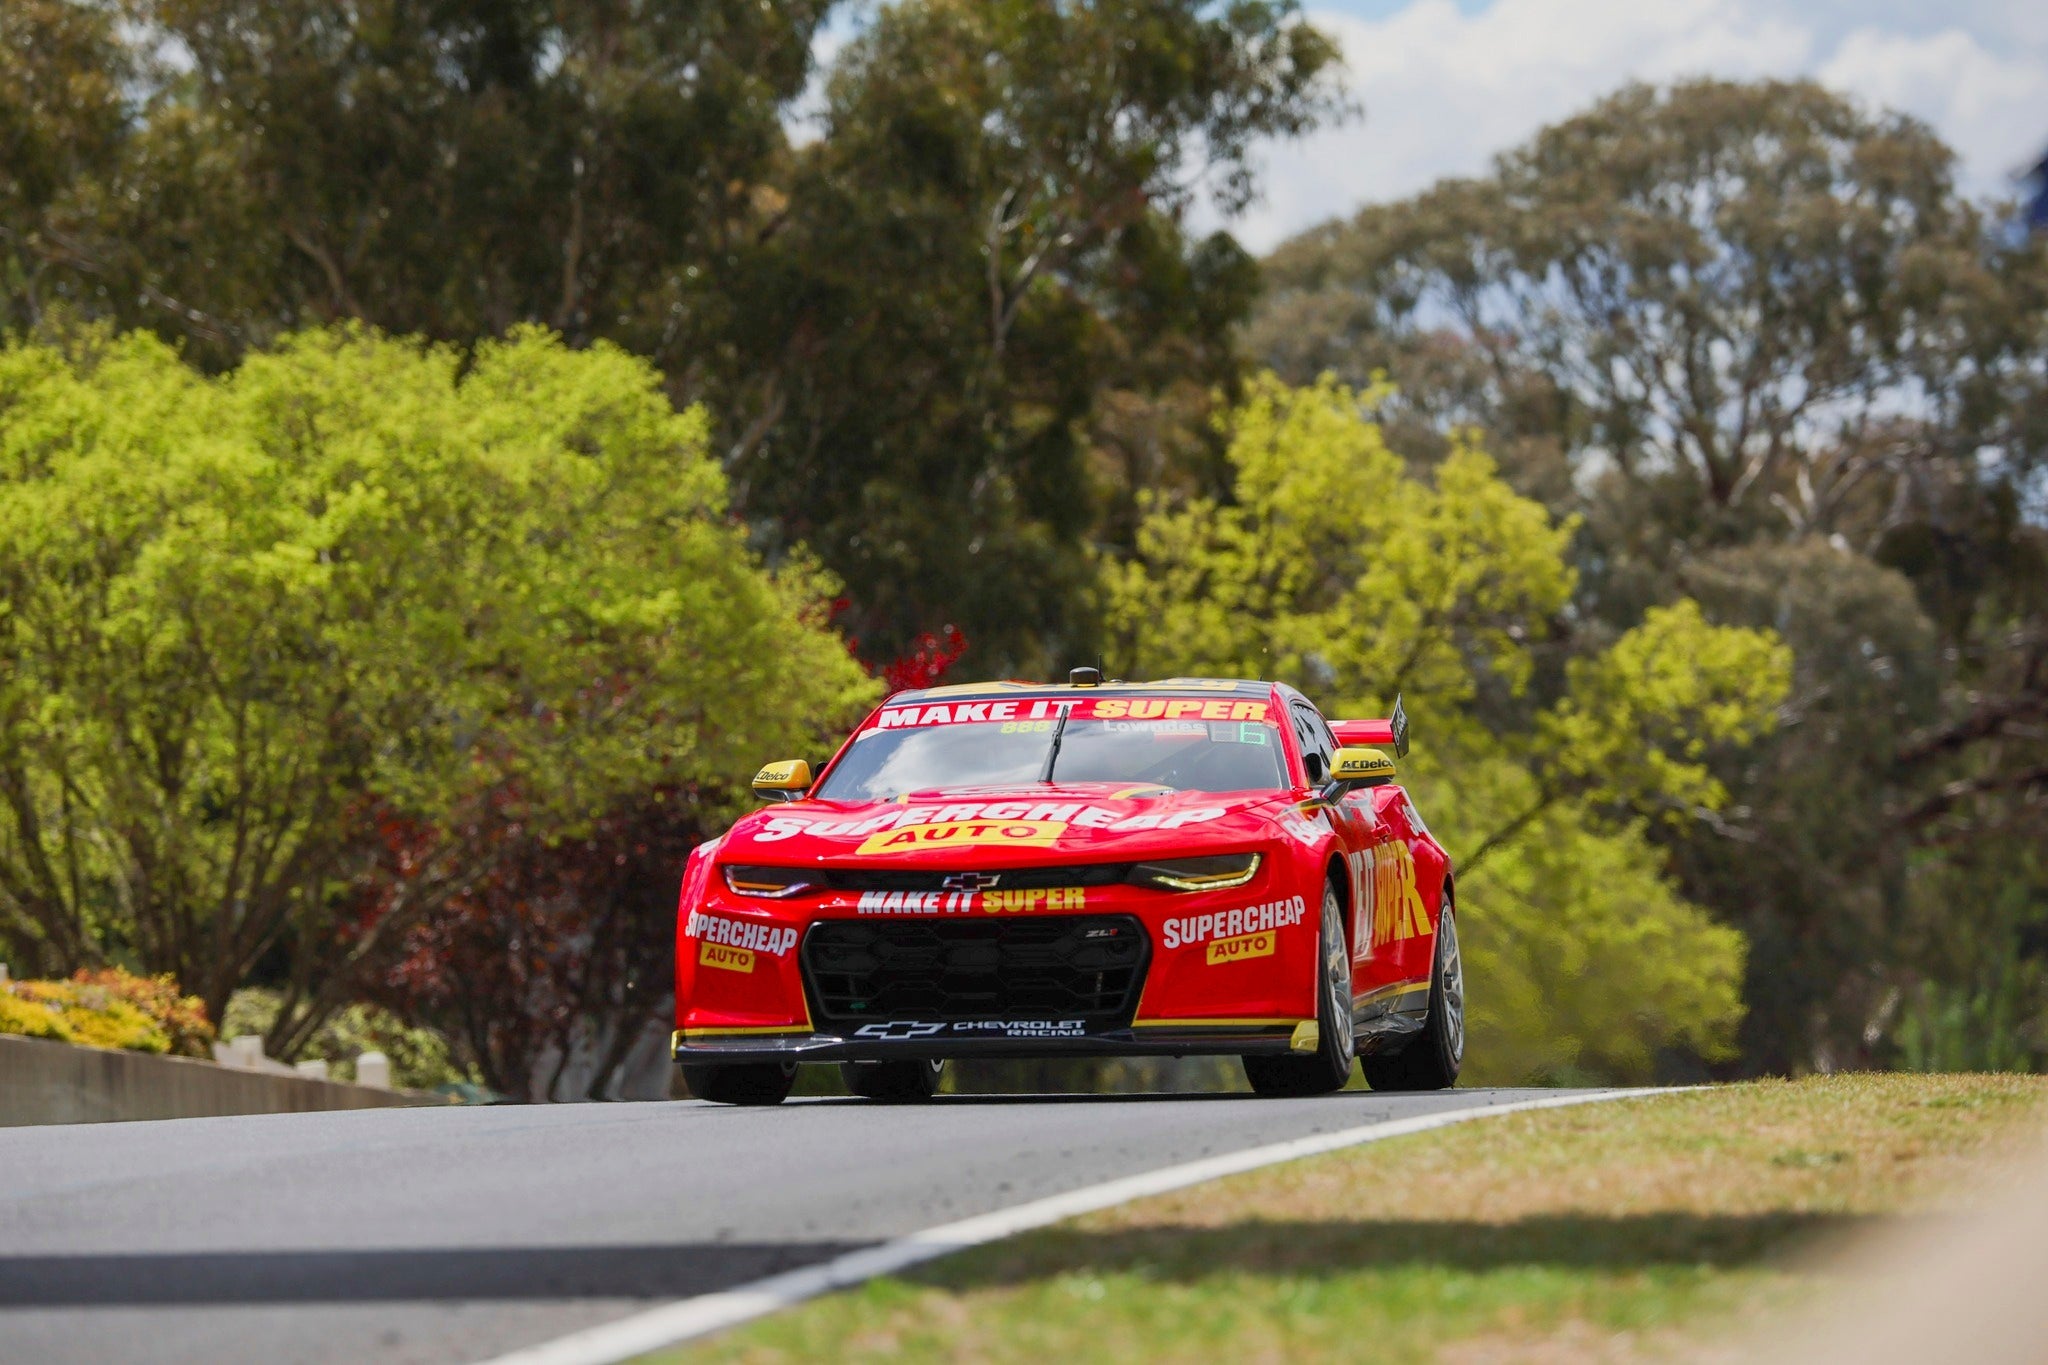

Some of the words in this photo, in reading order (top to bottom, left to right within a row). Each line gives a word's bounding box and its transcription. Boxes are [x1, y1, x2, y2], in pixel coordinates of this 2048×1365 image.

[878, 702, 1021, 728] MAKE
[1030, 699, 1083, 721] IT
[1092, 699, 1270, 721] SUPER
[753, 803, 1226, 842] SUPERCHEAP
[882, 825, 1038, 846] AUTO
[857, 891, 940, 914] MAKE
[946, 891, 977, 913] IT
[982, 887, 1085, 913] SUPER
[1163, 895, 1306, 949] SUPERCHEAP
[706, 946, 749, 966] AUTO
[1214, 936, 1268, 958] AUTO
[952, 1019, 1086, 1031] CHEVROLET
[1007, 1028, 1086, 1037] RACING
